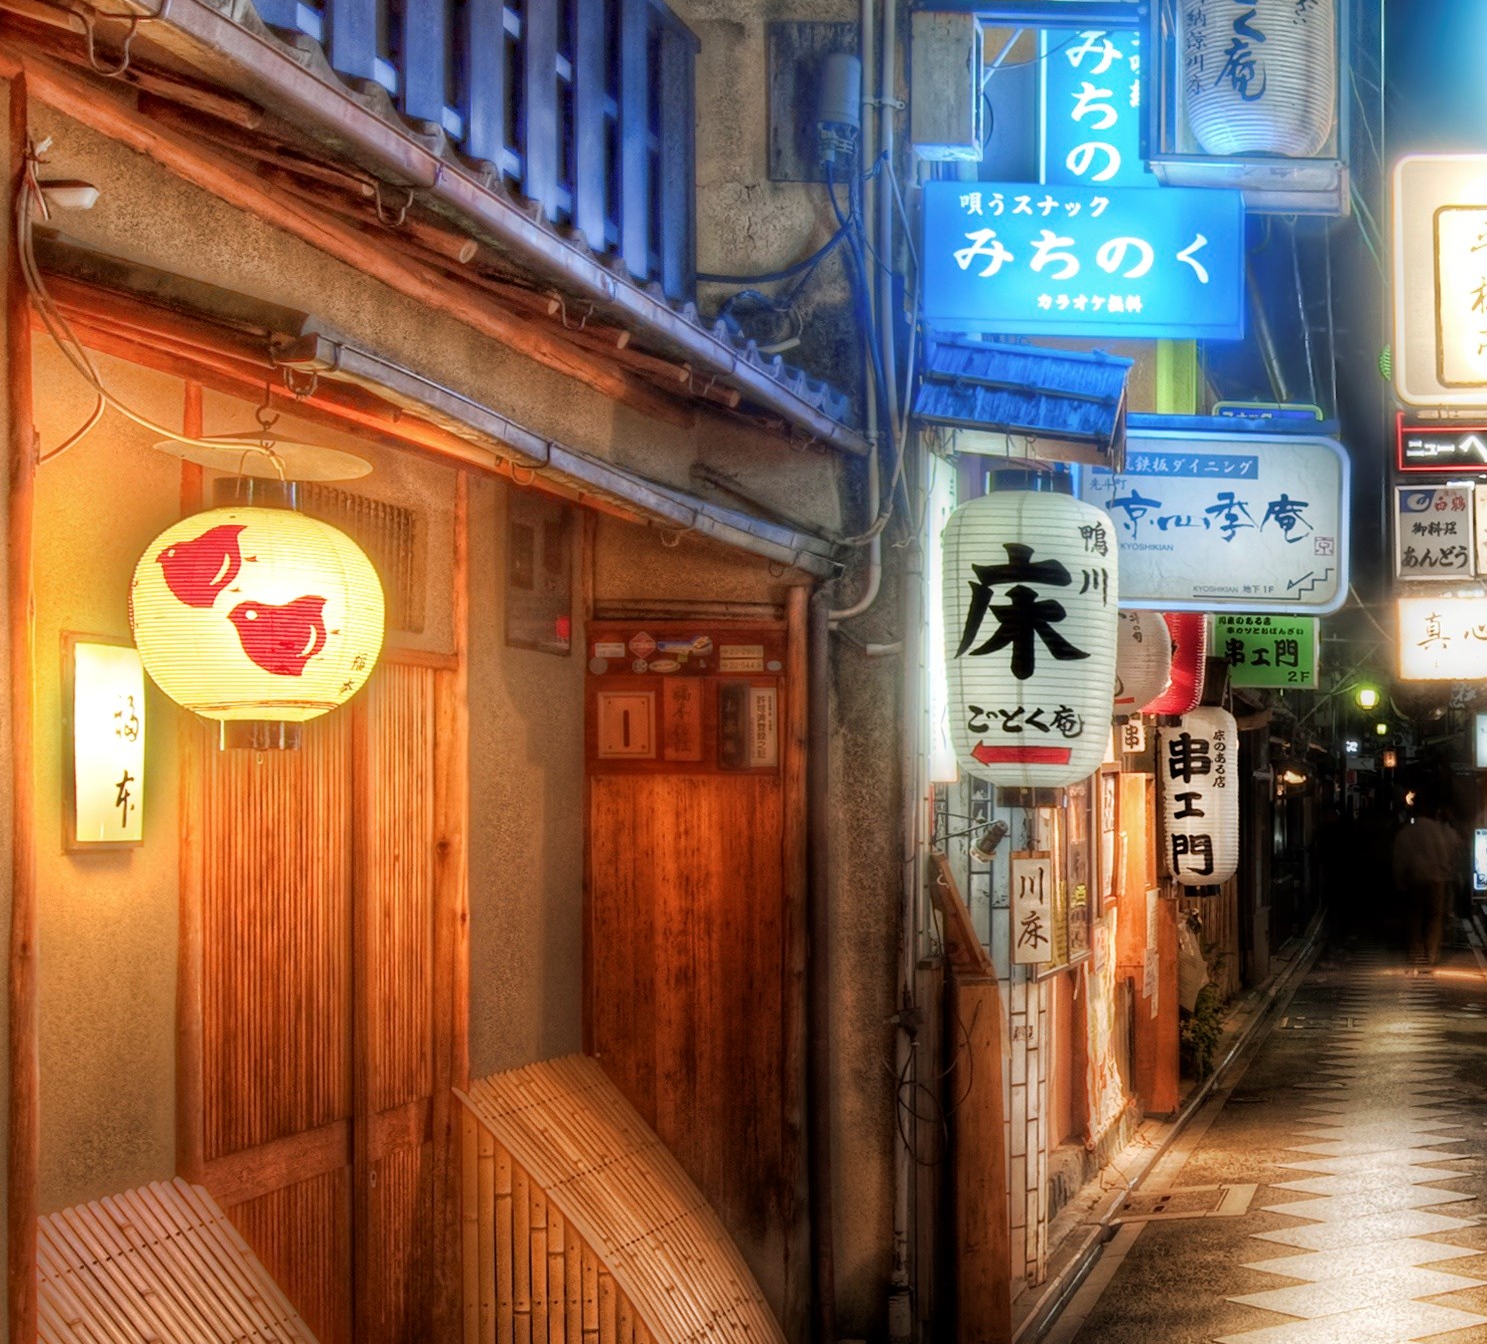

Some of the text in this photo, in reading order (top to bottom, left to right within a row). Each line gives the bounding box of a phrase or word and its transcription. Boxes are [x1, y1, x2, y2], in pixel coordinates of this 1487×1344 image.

[959, 192, 1110, 217] 唄うスナック
[953, 228, 1209, 284] みちのく
[1412, 521, 1457, 537] 御料理
[1120, 543, 1174, 551] KYOSHIKIAN
[1401, 545, 1469, 570] あんどう
[1078, 521, 1109, 607] 鴨川
[954, 542, 1091, 680] 床
[1287, 671, 1310, 683] 2F
[968, 705, 1085, 738] ごとく庵
[1125, 724, 1139, 749] 串
[1213, 729, 1226, 789] 床のある店
[1018, 867, 1049, 950] 川床
